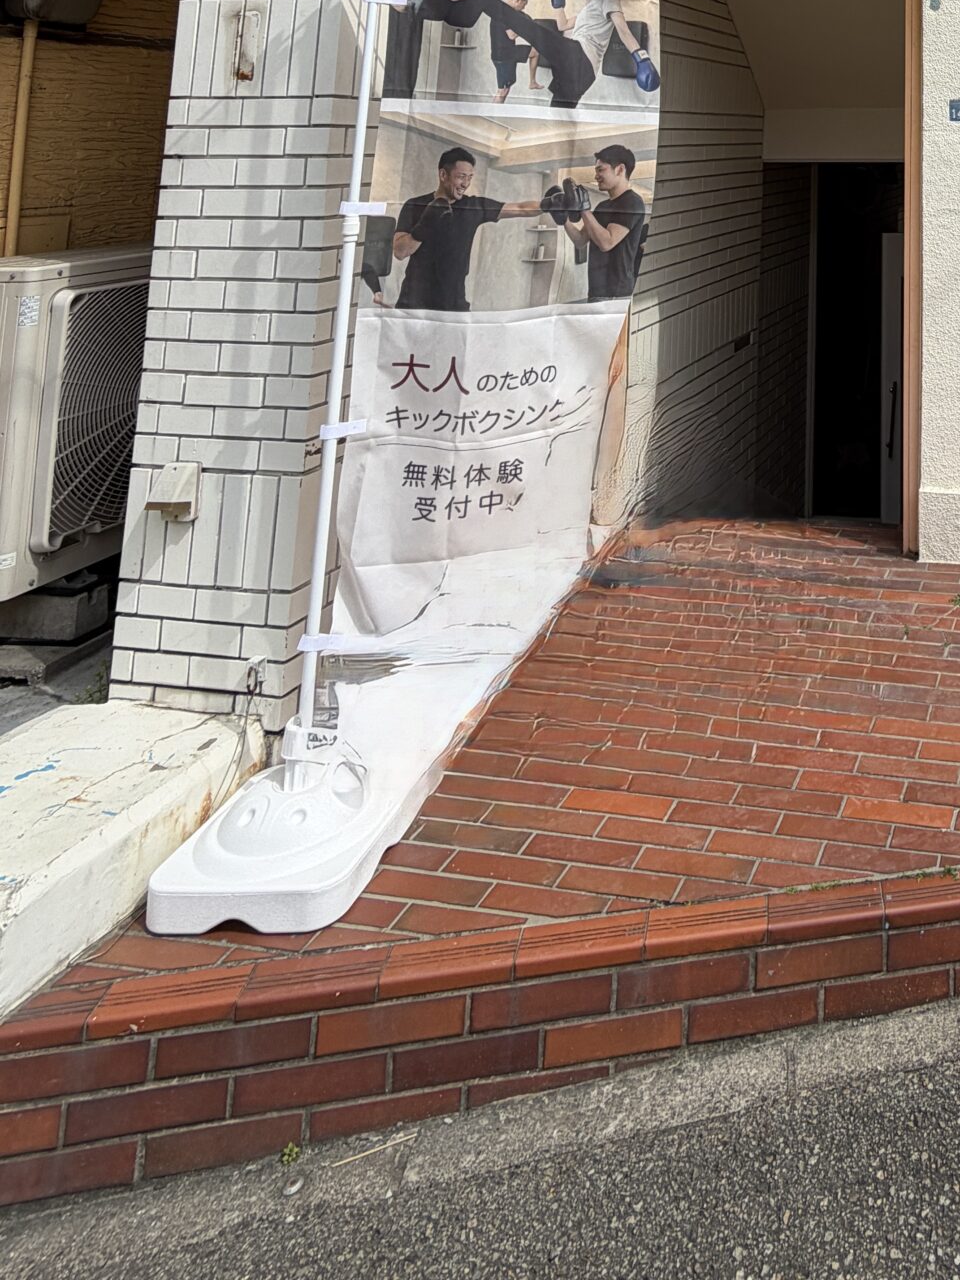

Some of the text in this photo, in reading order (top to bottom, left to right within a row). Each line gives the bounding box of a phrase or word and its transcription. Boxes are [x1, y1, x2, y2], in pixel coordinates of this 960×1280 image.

[390, 354, 558, 396] 大人のための
[401, 458, 524, 491] 無料体験
